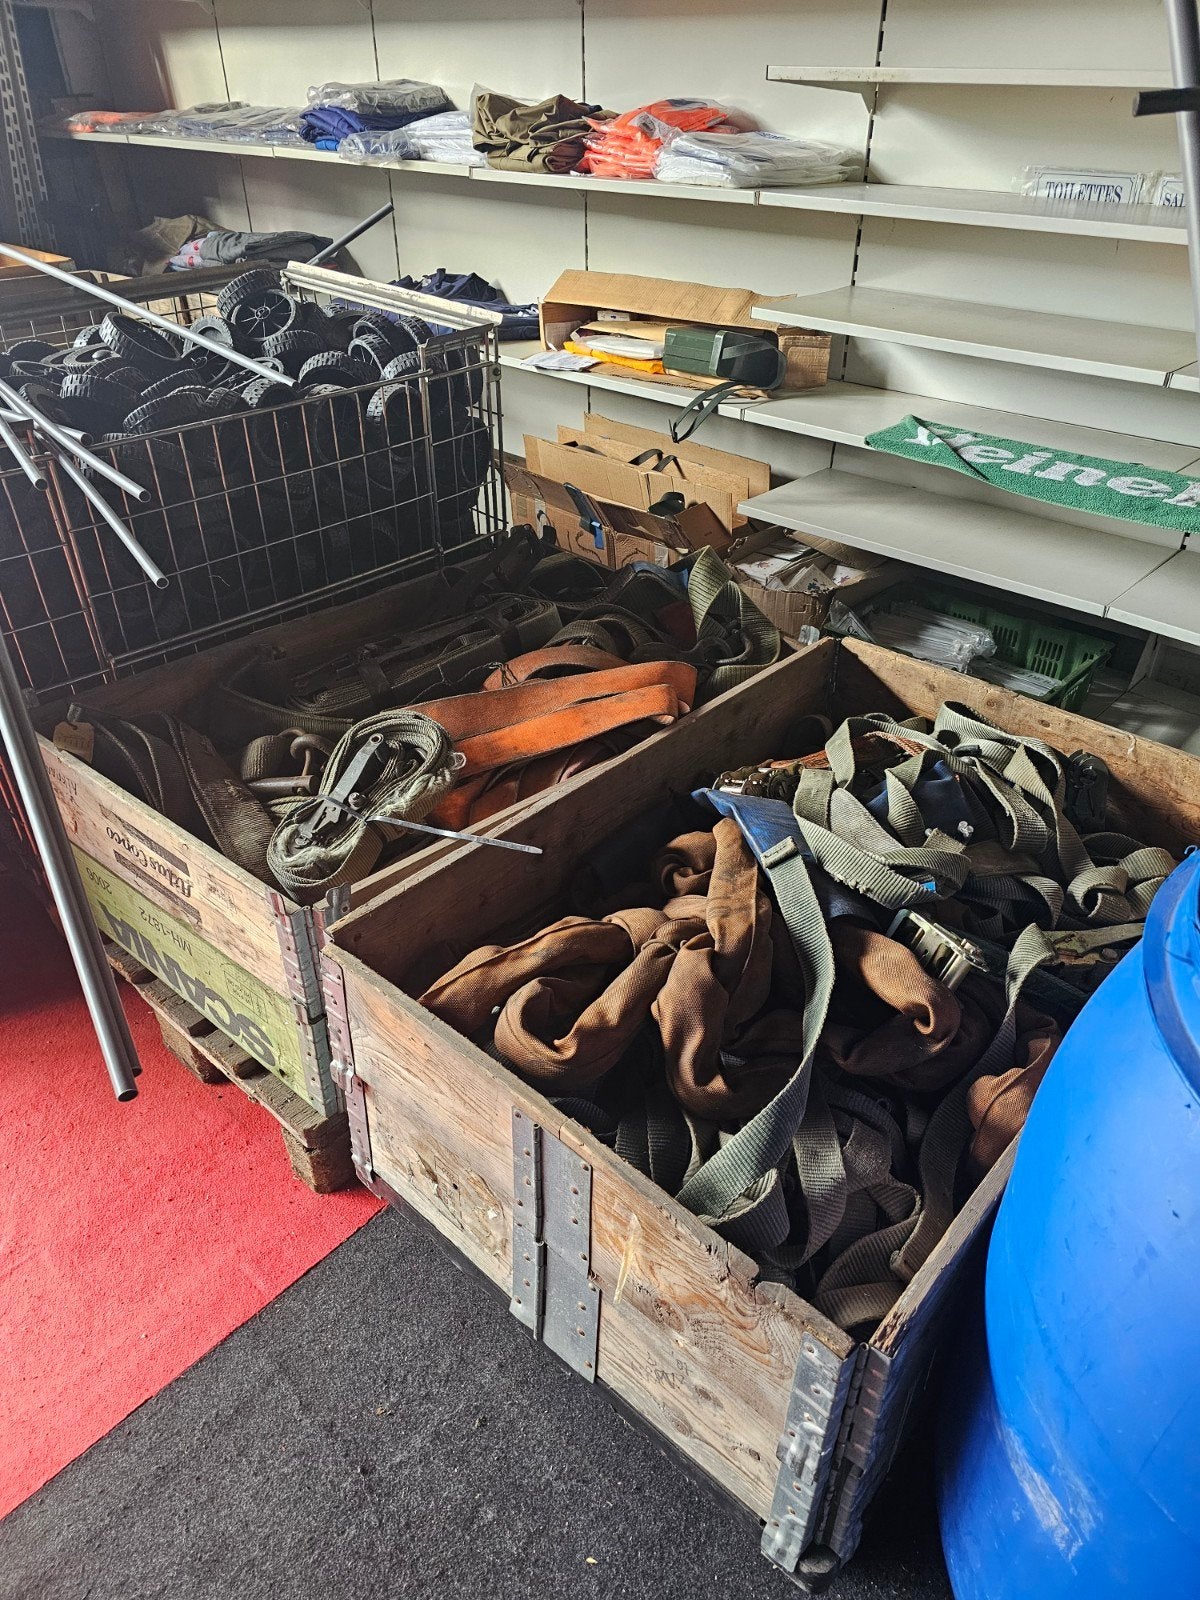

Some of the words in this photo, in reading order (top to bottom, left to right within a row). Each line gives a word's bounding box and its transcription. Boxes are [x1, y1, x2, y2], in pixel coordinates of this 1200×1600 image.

[1045, 181, 1123, 204] TOILETTES
[1163, 193, 1186, 208] SAL
[96, 899, 277, 1067] SCANIA
